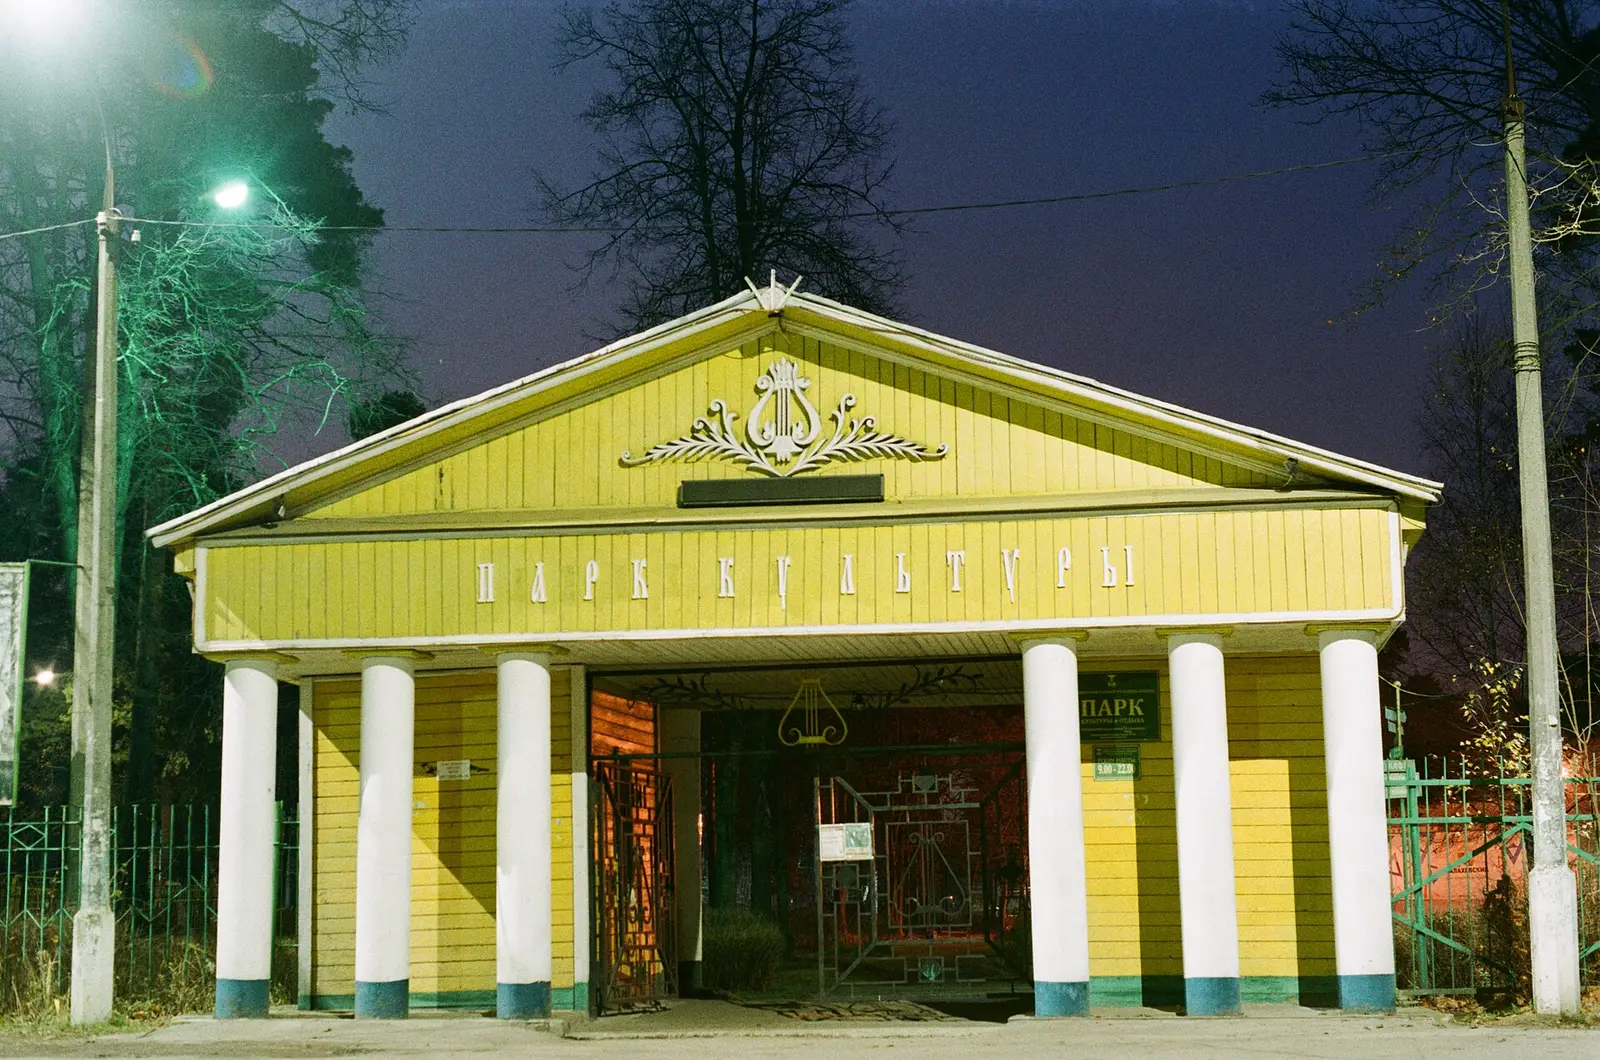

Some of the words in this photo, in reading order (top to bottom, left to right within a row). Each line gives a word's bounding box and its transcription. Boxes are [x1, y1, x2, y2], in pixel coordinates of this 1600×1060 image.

[477, 558, 649, 603] ПАРК
[719, 543, 1136, 610] КУЛЬТУРЫ
[1081, 698, 1144, 717] ПАРК
[1097, 764, 1113, 774] 9.00
